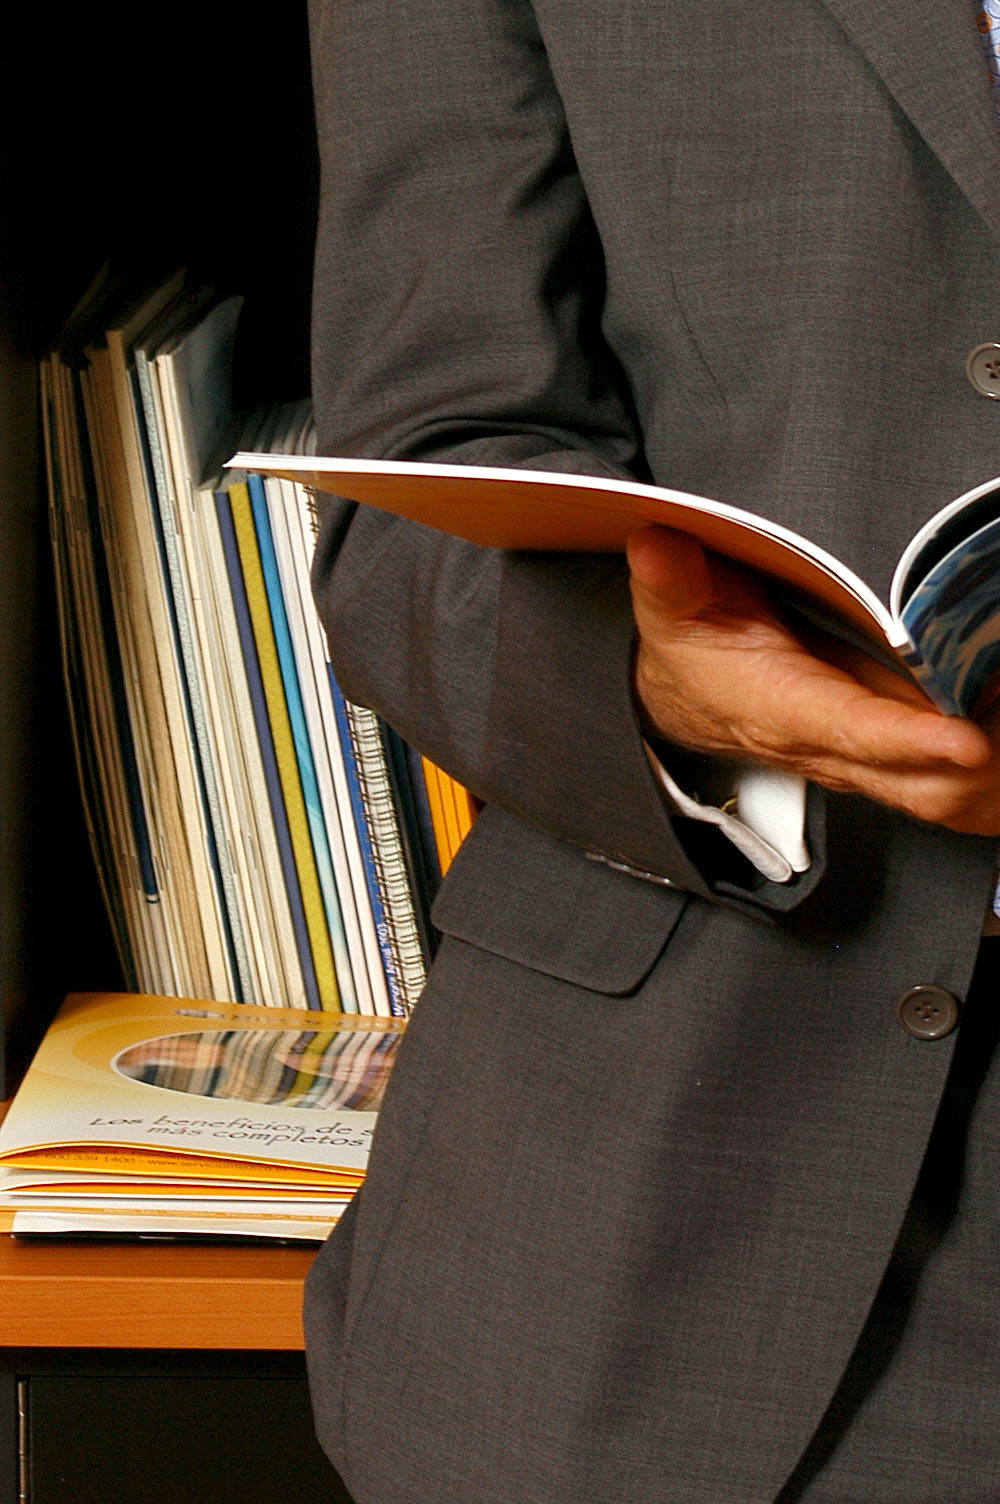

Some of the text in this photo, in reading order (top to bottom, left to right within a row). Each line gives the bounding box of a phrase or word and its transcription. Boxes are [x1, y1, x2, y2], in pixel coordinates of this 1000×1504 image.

[89, 1115, 352, 1136] Los beneficios de
[147, 1125, 364, 1147] más completos
